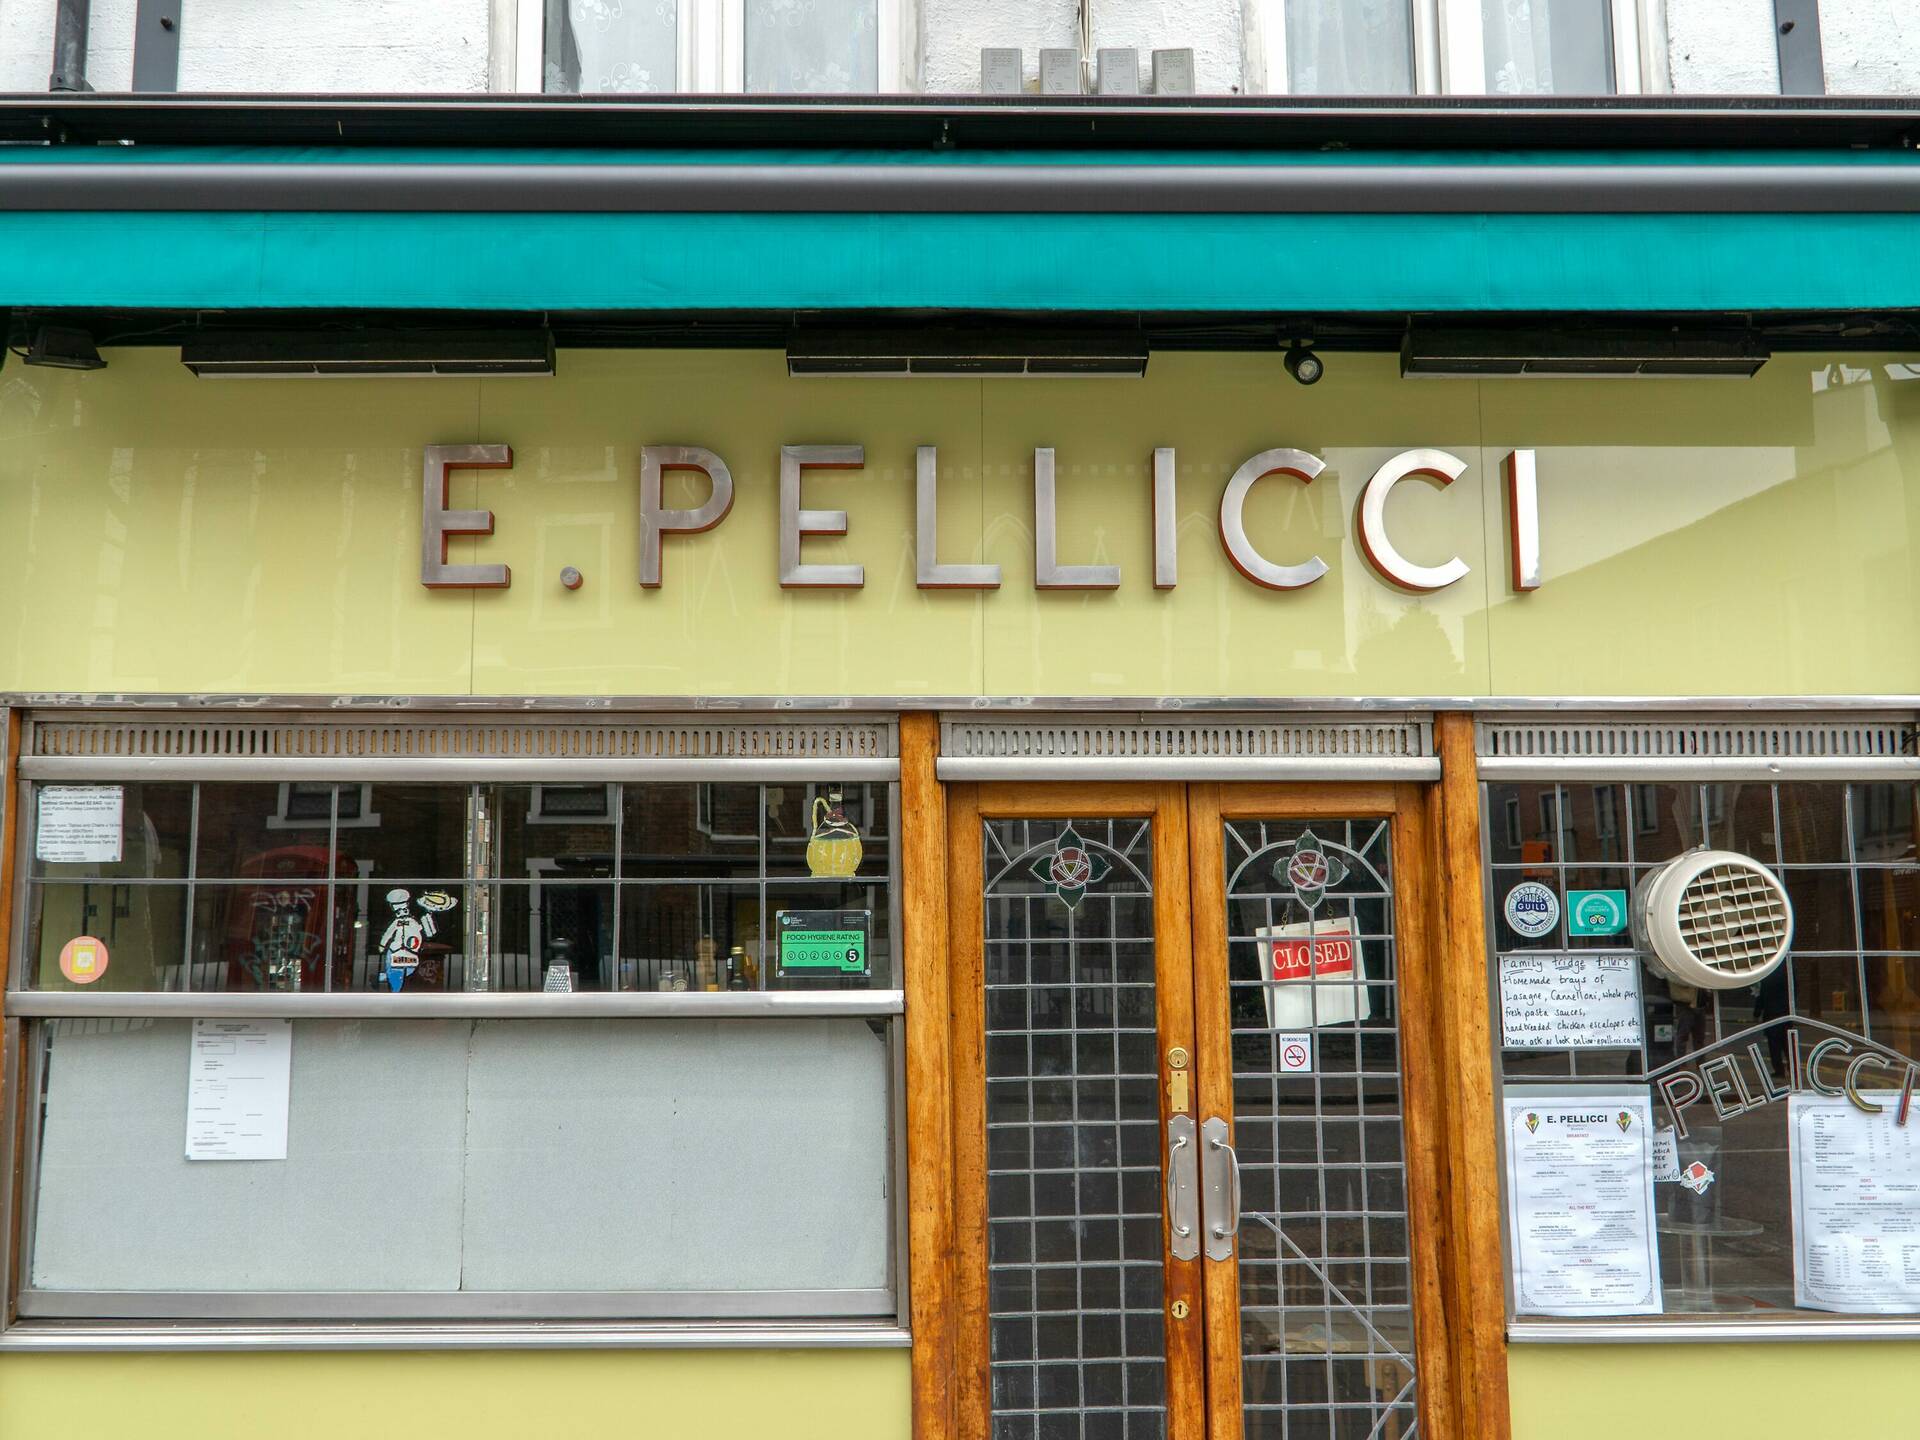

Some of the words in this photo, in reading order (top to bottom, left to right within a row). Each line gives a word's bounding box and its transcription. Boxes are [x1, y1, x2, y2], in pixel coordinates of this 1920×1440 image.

[1517, 902, 1547, 911] GUILD
[836, 933, 861, 941] RATING
[848, 950, 857, 961] 5
[1273, 941, 1351, 970] CLOSED
[1559, 974, 1587, 992] trays
[1594, 974, 1605, 985] of
[1602, 988, 1622, 999] whole
[1505, 1006, 1522, 1018] fresh
[1524, 1008, 1549, 1021] pasta
[1557, 1020, 1586, 1030] chicken
[1589, 1018, 1625, 1030] escalopes
[1529, 1036, 1544, 1046] ask
[1554, 1034, 1571, 1045] look
[1656, 1028, 1917, 1140] PELLICCI
[1546, 1115, 1557, 1124] E.
[1559, 1114, 1608, 1124] PELLICCI
